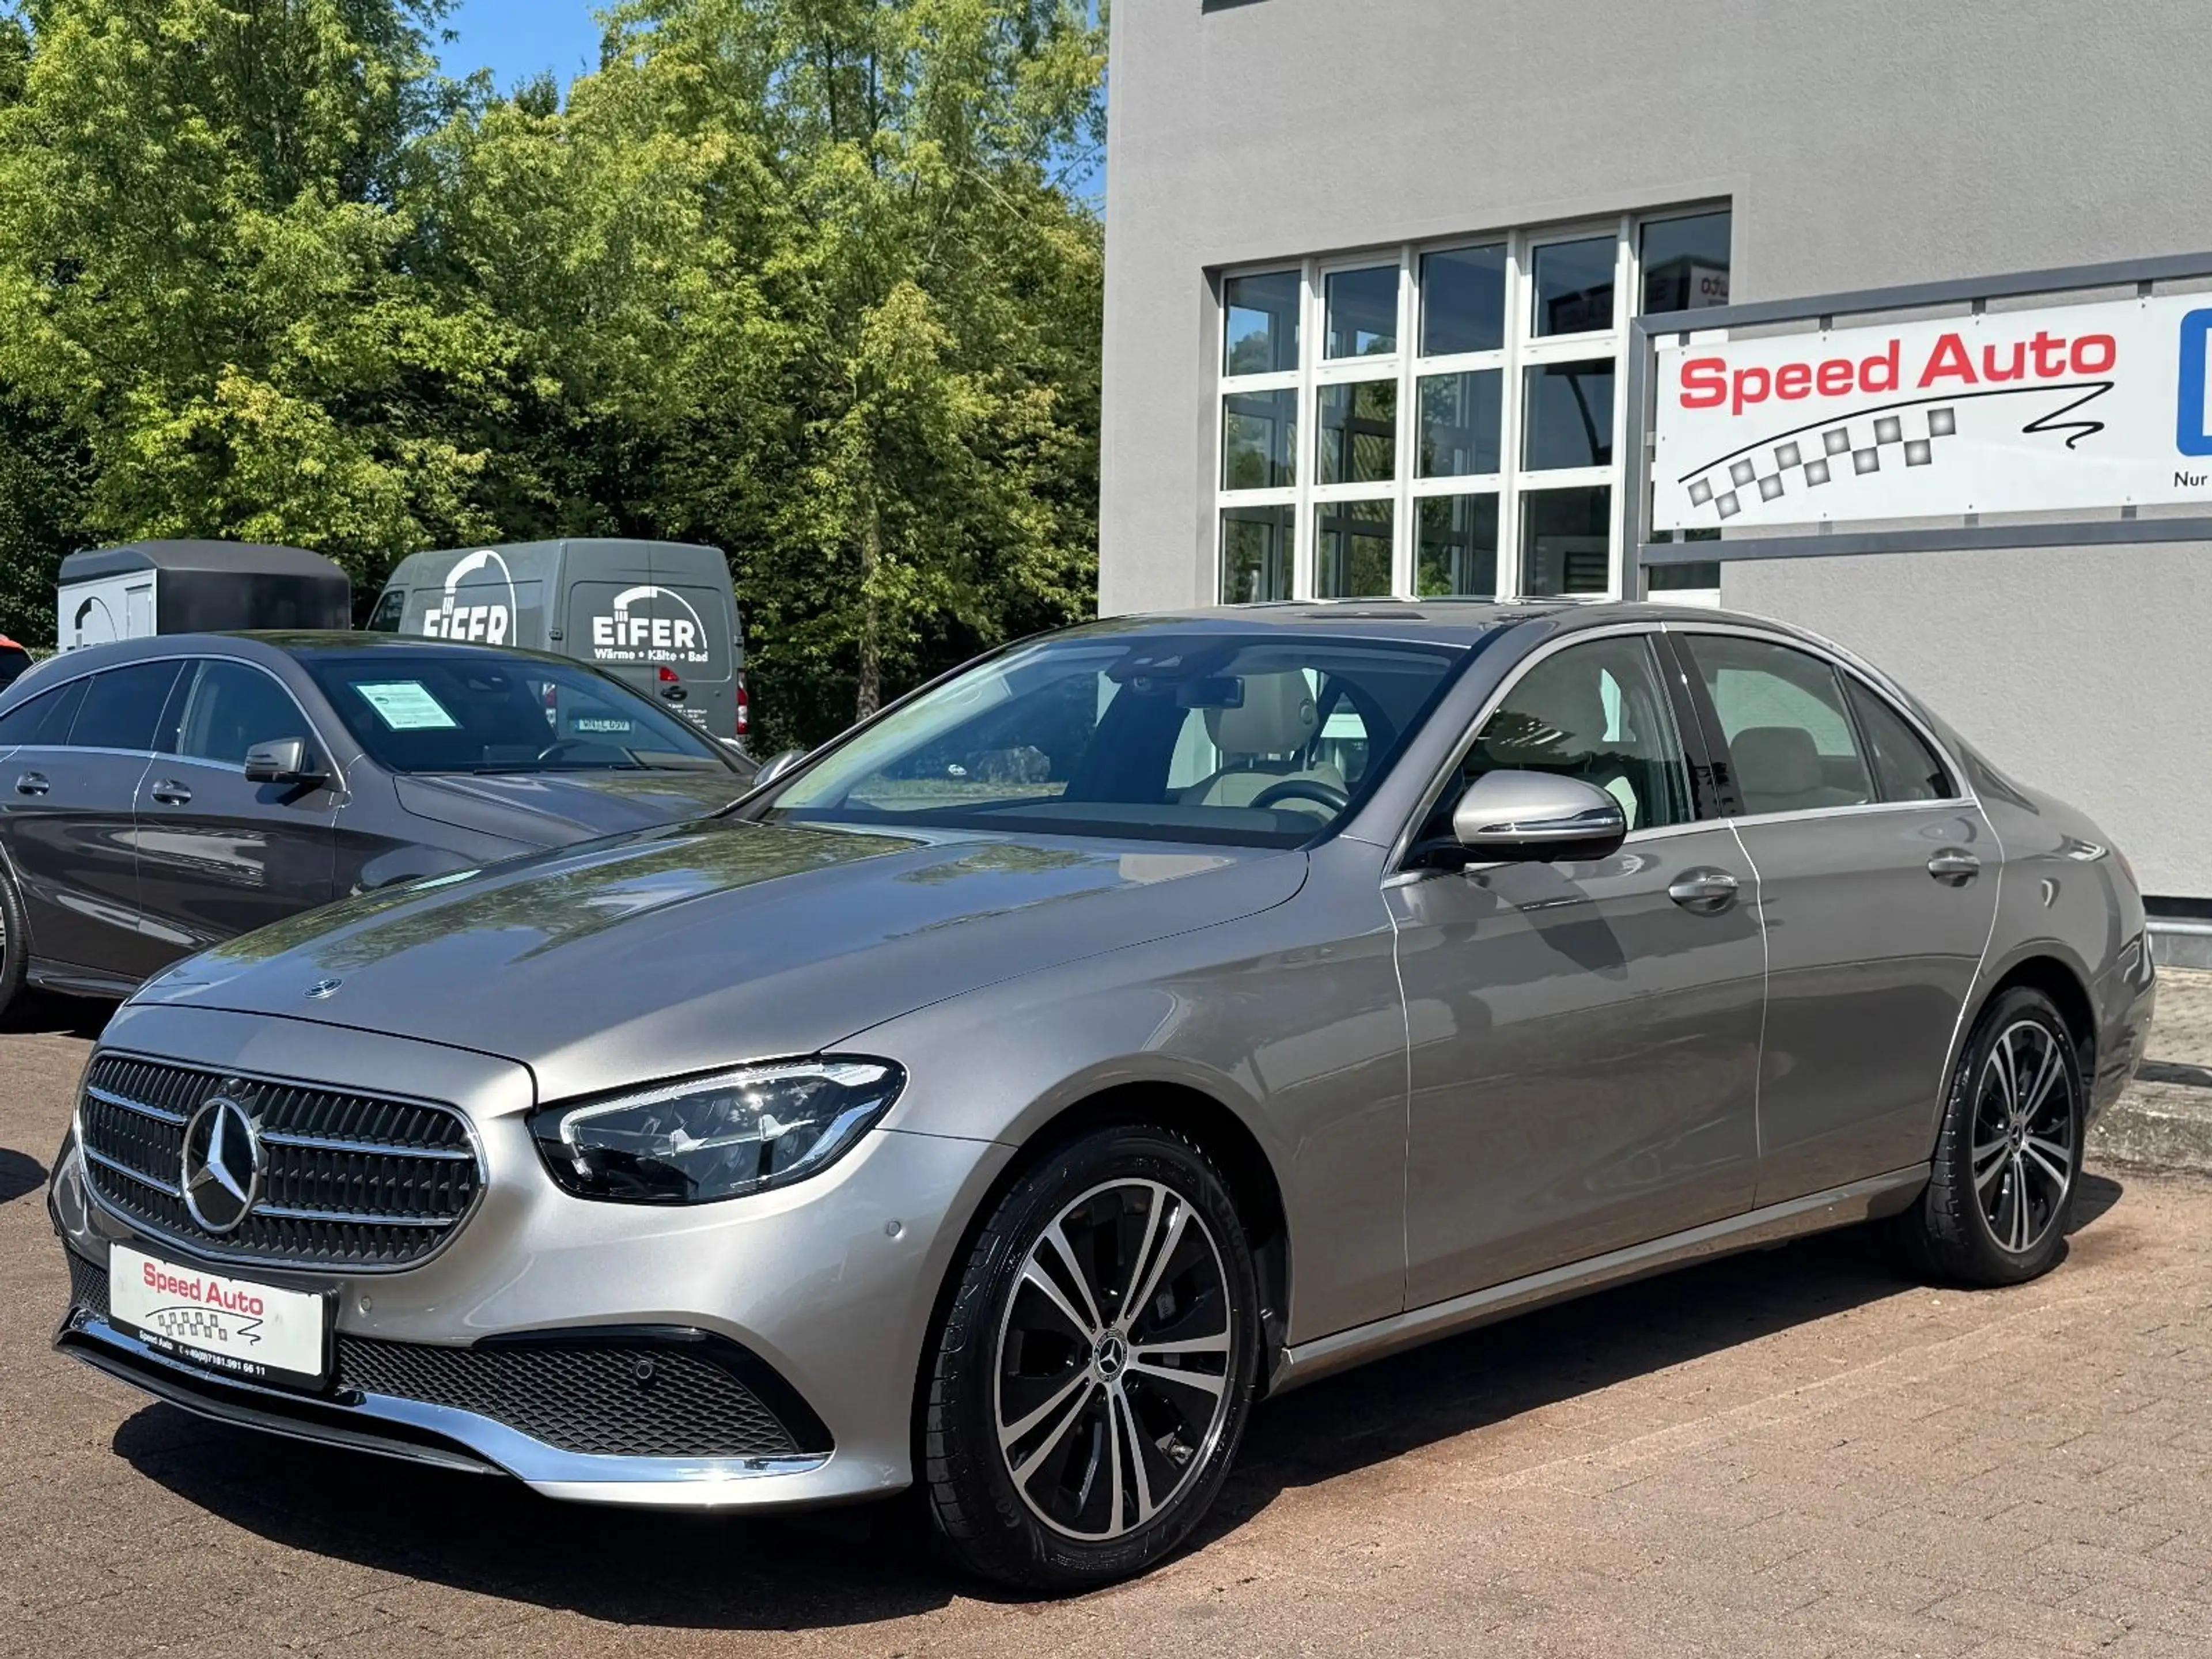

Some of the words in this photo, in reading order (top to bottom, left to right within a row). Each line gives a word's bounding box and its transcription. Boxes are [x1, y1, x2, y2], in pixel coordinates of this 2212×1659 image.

[1680, 338, 1900, 416] Speed
[1917, 331, 2116, 388] Auto
[2174, 471, 2209, 488] Nur
[594, 648, 635, 660] Wärme
[647, 649, 677, 661] Kälte
[688, 651, 709, 662] Bad
[143, 1262, 202, 1302] Speed
[206, 1281, 264, 1316] Auto
